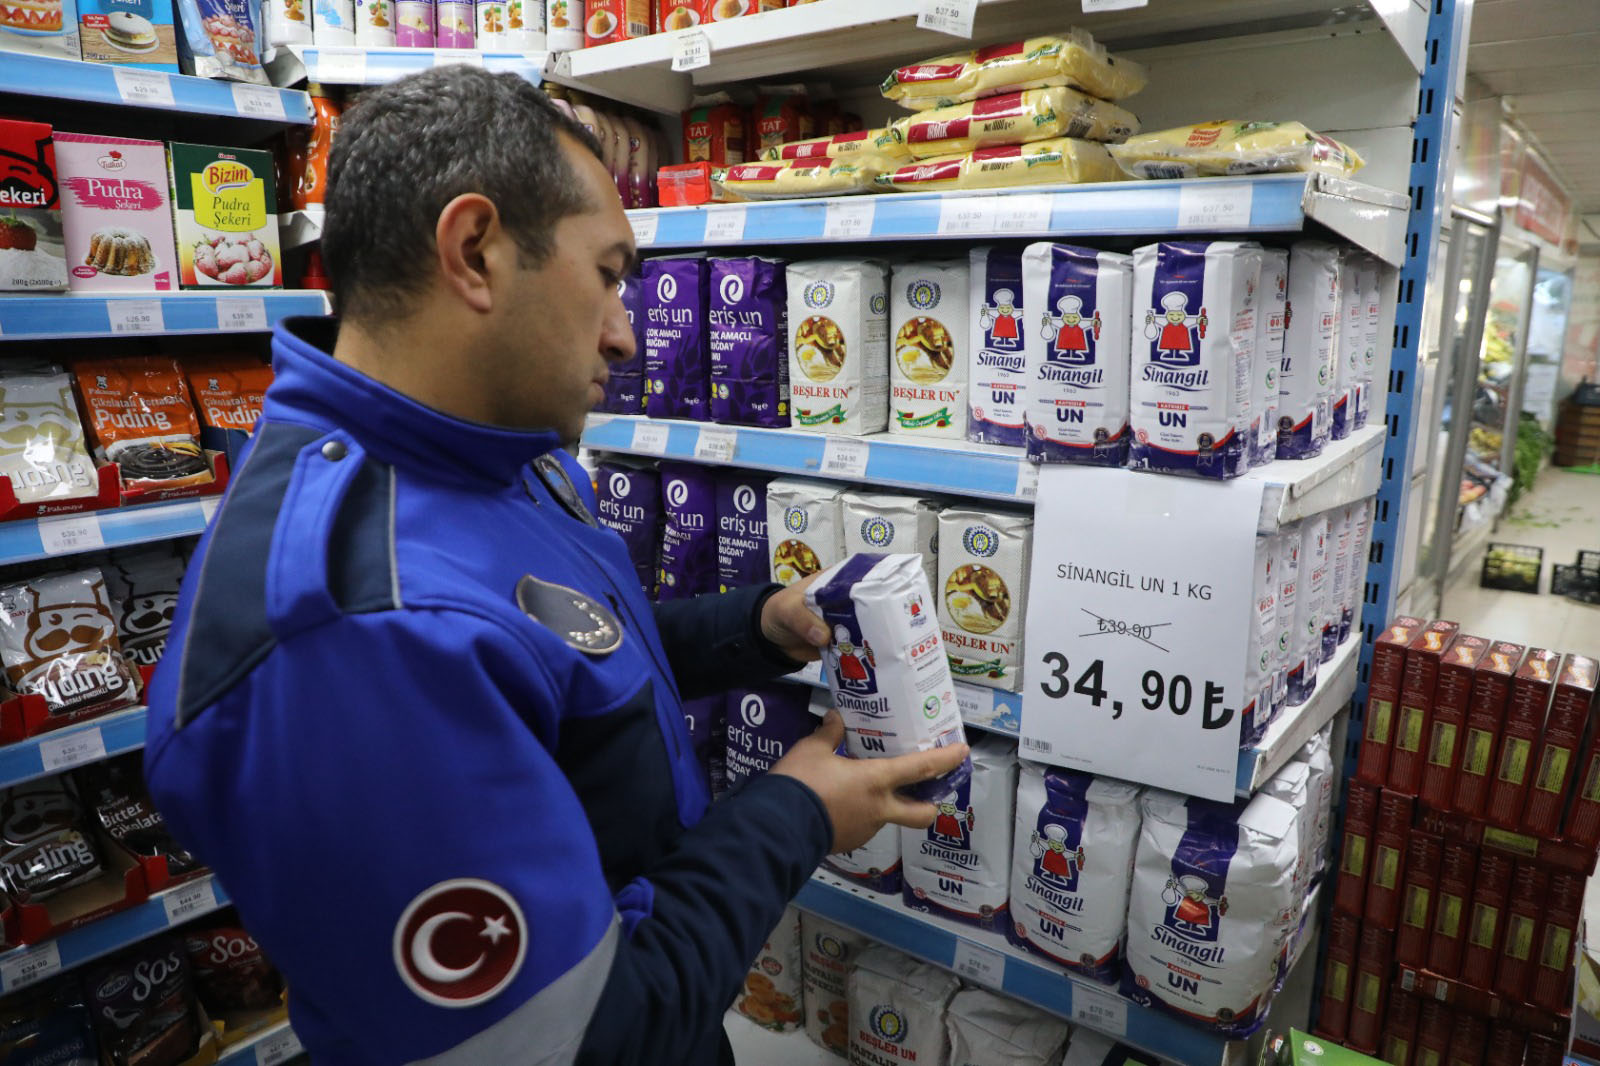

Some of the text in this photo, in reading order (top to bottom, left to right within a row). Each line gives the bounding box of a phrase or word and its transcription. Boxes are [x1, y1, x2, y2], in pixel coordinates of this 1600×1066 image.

[690, 125, 708, 137] TAT
[762, 120, 780, 132] TAT
[209, 165, 249, 187] Bizim
[87, 179, 144, 201] Pudra
[212, 196, 250, 212] Pudra
[213, 211, 252, 229] Şekeri
[648, 304, 693, 326] eriş un
[709, 305, 763, 329] eriş un
[721, 330, 752, 343] AMAÇLI
[1037, 363, 1102, 384] Sinangil
[1142, 364, 1208, 387] Sinangil
[793, 384, 850, 401] BEŞLER UN
[893, 386, 957, 403] BEŞLER UN
[992, 391, 1015, 405] UN
[95, 409, 172, 431] Puding
[1056, 408, 1084, 424] UN
[1159, 411, 1187, 428] UN
[599, 498, 621, 520] eriş
[623, 504, 645, 520] un
[681, 511, 704, 528] un
[720, 513, 746, 537] eriş
[1057, 561, 1213, 603] SİNANGİL UN 1 KG
[1096, 617, 1153, 641] ₺39.90
[942, 630, 1011, 655] BEŞLER UN
[836, 691, 889, 714] Sinangil
[726, 724, 784, 759] eriş un
[860, 735, 886, 753] UN
[101, 802, 145, 829] Bitter
[2, 837, 95, 883] Puding
[919, 841, 980, 869] Sinangil
[938, 877, 964, 896] UN
[1024, 873, 1085, 914] Sinangil
[1039, 917, 1065, 942] UN
[1150, 925, 1226, 965] Sinangil
[1167, 971, 1199, 996] UN
[859, 1030, 917, 1063] BEŞLER UN
